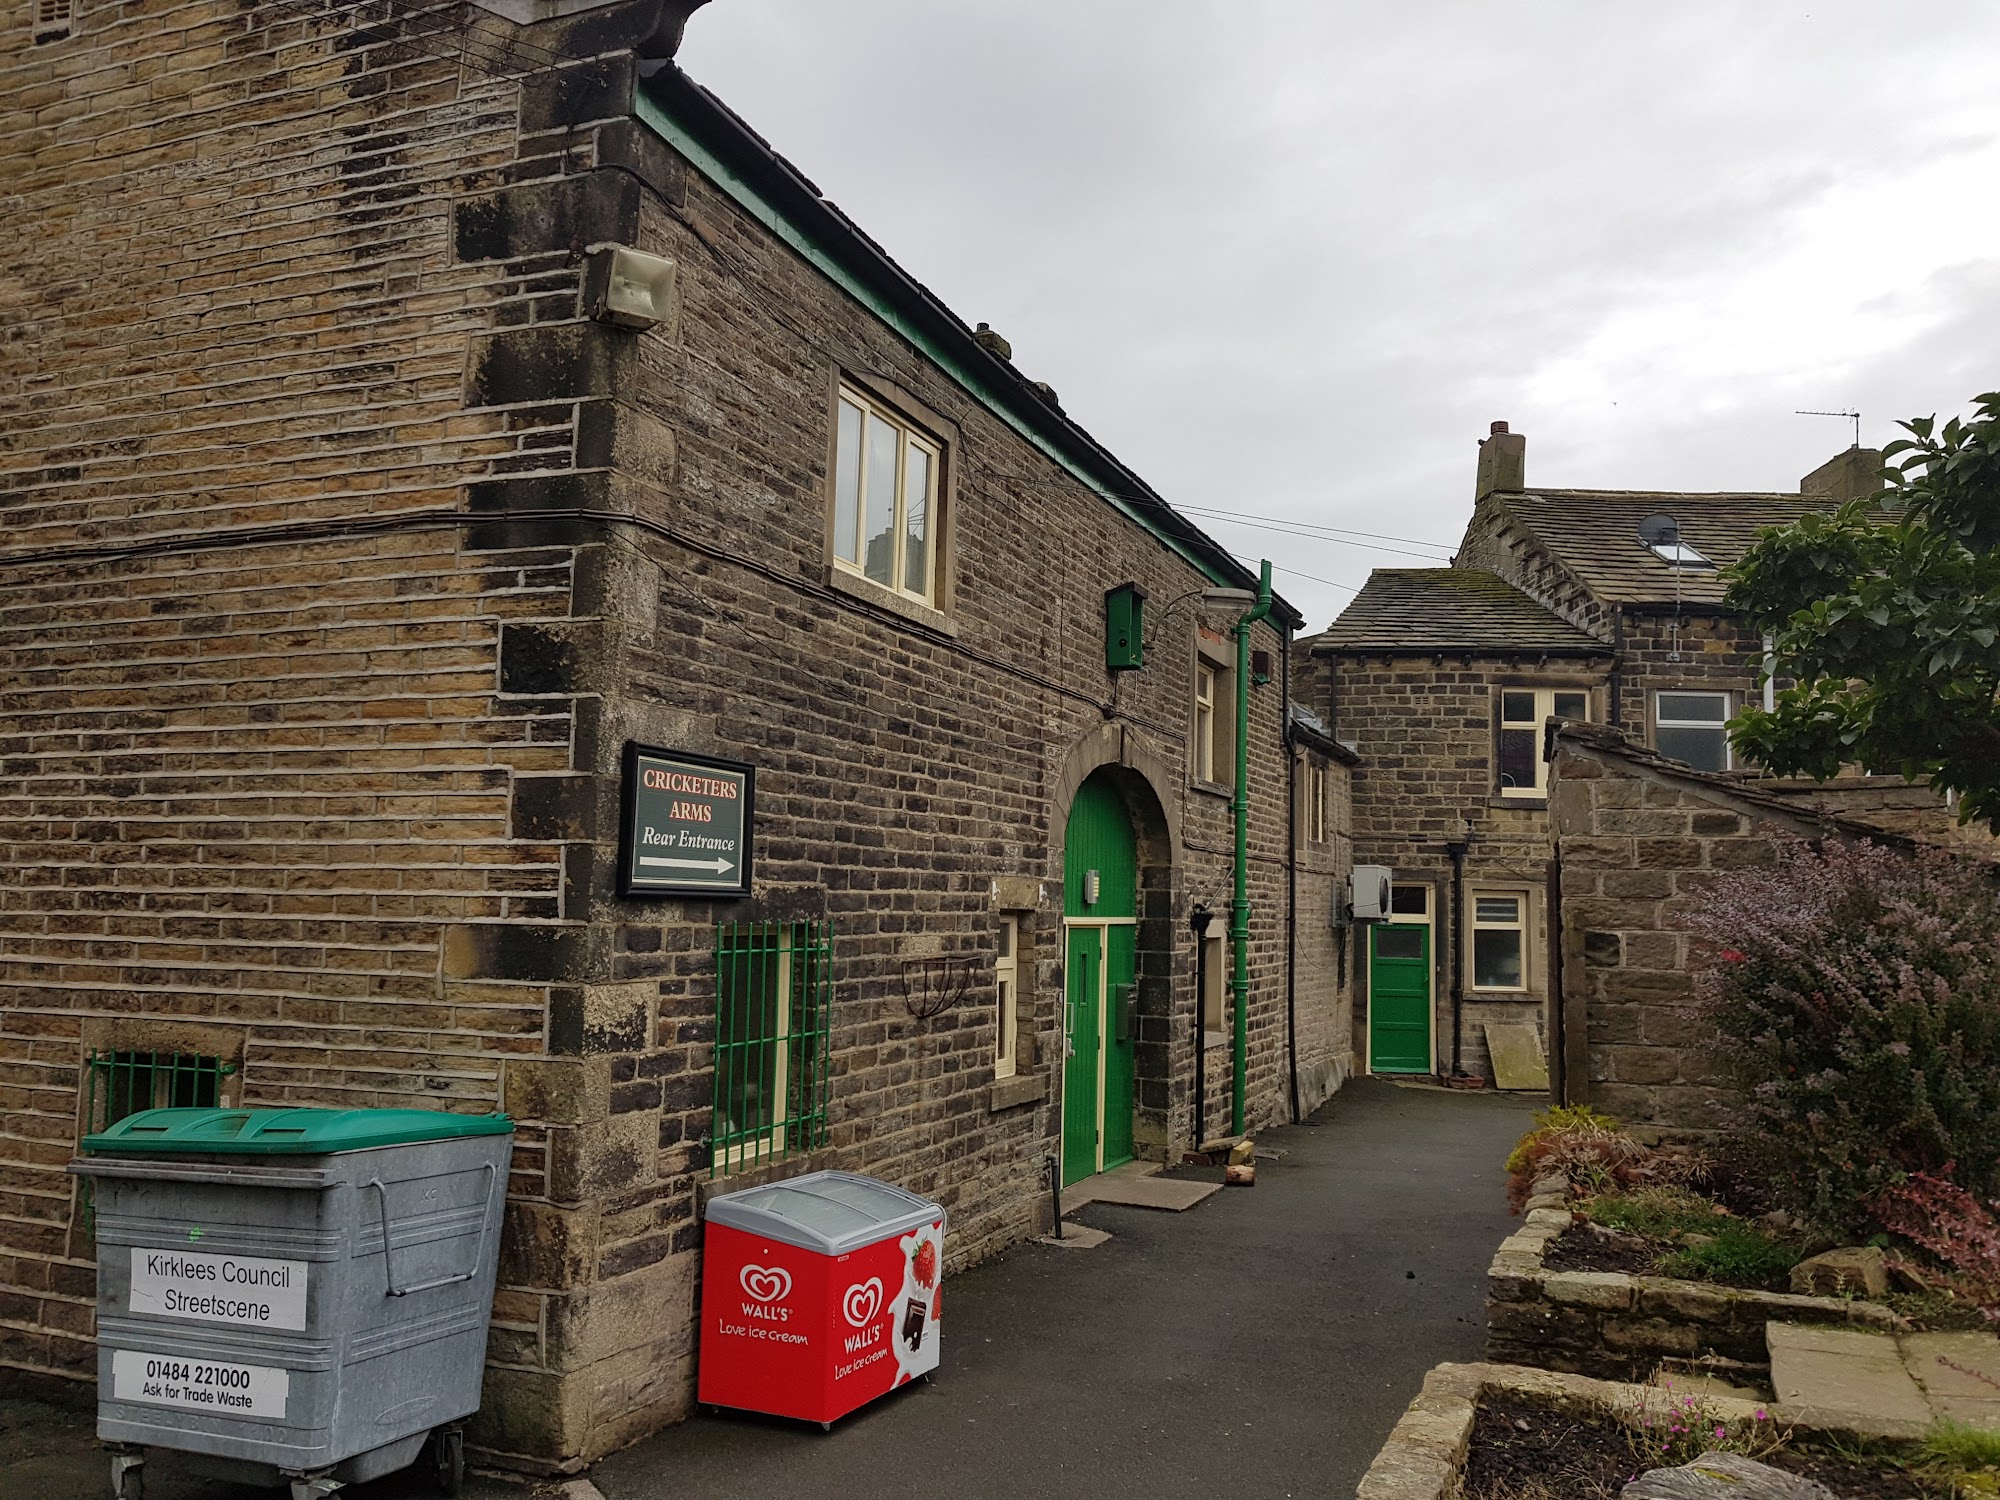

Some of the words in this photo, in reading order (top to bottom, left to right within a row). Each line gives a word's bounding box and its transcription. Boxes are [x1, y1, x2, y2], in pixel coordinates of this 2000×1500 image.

[643, 769, 737, 799] CRICKETERS
[669, 801, 712, 822] ARMS
[642, 826, 676, 846] Rear
[678, 830, 735, 851] Entrance
[147, 1254, 216, 1281] Kirklees
[222, 1261, 290, 1288] Council
[164, 1288, 270, 1321] Streetscene
[741, 1302, 788, 1322] WALL'S
[719, 1318, 746, 1336] Love
[748, 1325, 767, 1338] ice
[844, 1325, 881, 1354] WALL'S
[146, 1360, 189, 1382] 01484
[194, 1366, 250, 1389] 221000
[835, 1365, 853, 1380] Love
[853, 1357, 865, 1371] ice
[142, 1382, 162, 1397] Ask
[165, 1384, 180, 1399] for
[183, 1387, 214, 1404] Trade
[217, 1391, 253, 1408] Waste
